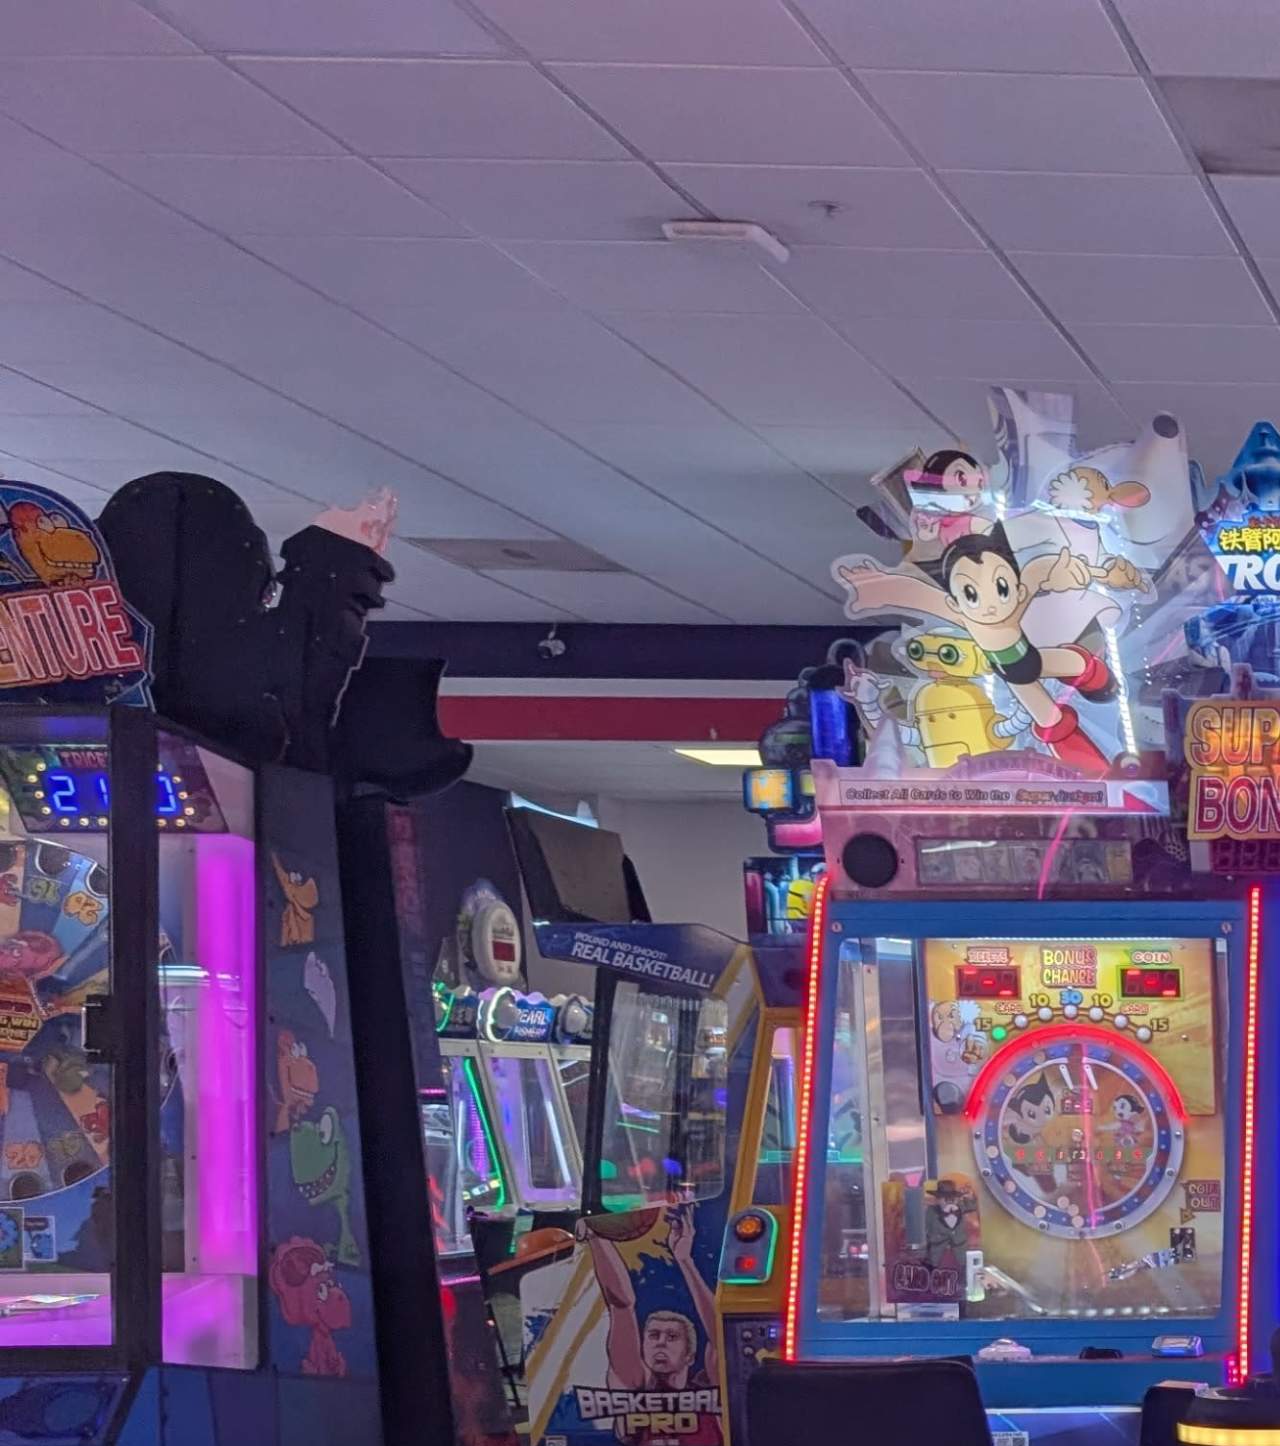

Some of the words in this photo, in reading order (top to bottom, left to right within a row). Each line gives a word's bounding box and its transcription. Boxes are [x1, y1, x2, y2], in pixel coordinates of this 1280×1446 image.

[846, 787, 889, 801] Collect
[890, 787, 908, 801] All
[911, 787, 947, 802] Cards
[949, 788, 962, 802] to
[964, 788, 987, 802] Win
[988, 787, 1010, 802] the
[1043, 948, 1096, 966] BONUS
[1132, 951, 1171, 964] COIN
[571, 942, 610, 965] REAL
[612, 951, 715, 989] BASKETBALL!
[1043, 968, 1094, 985] CHANCE
[1030, 992, 1050, 1008] 10
[1060, 990, 1083, 1006] 30
[1092, 992, 1113, 1008] 10
[976, 1018, 993, 1032] 15
[1151, 1018, 1169, 1032] 15
[576, 1387, 723, 1420] BASKETBAL
[625, 1412, 698, 1435] PRO
